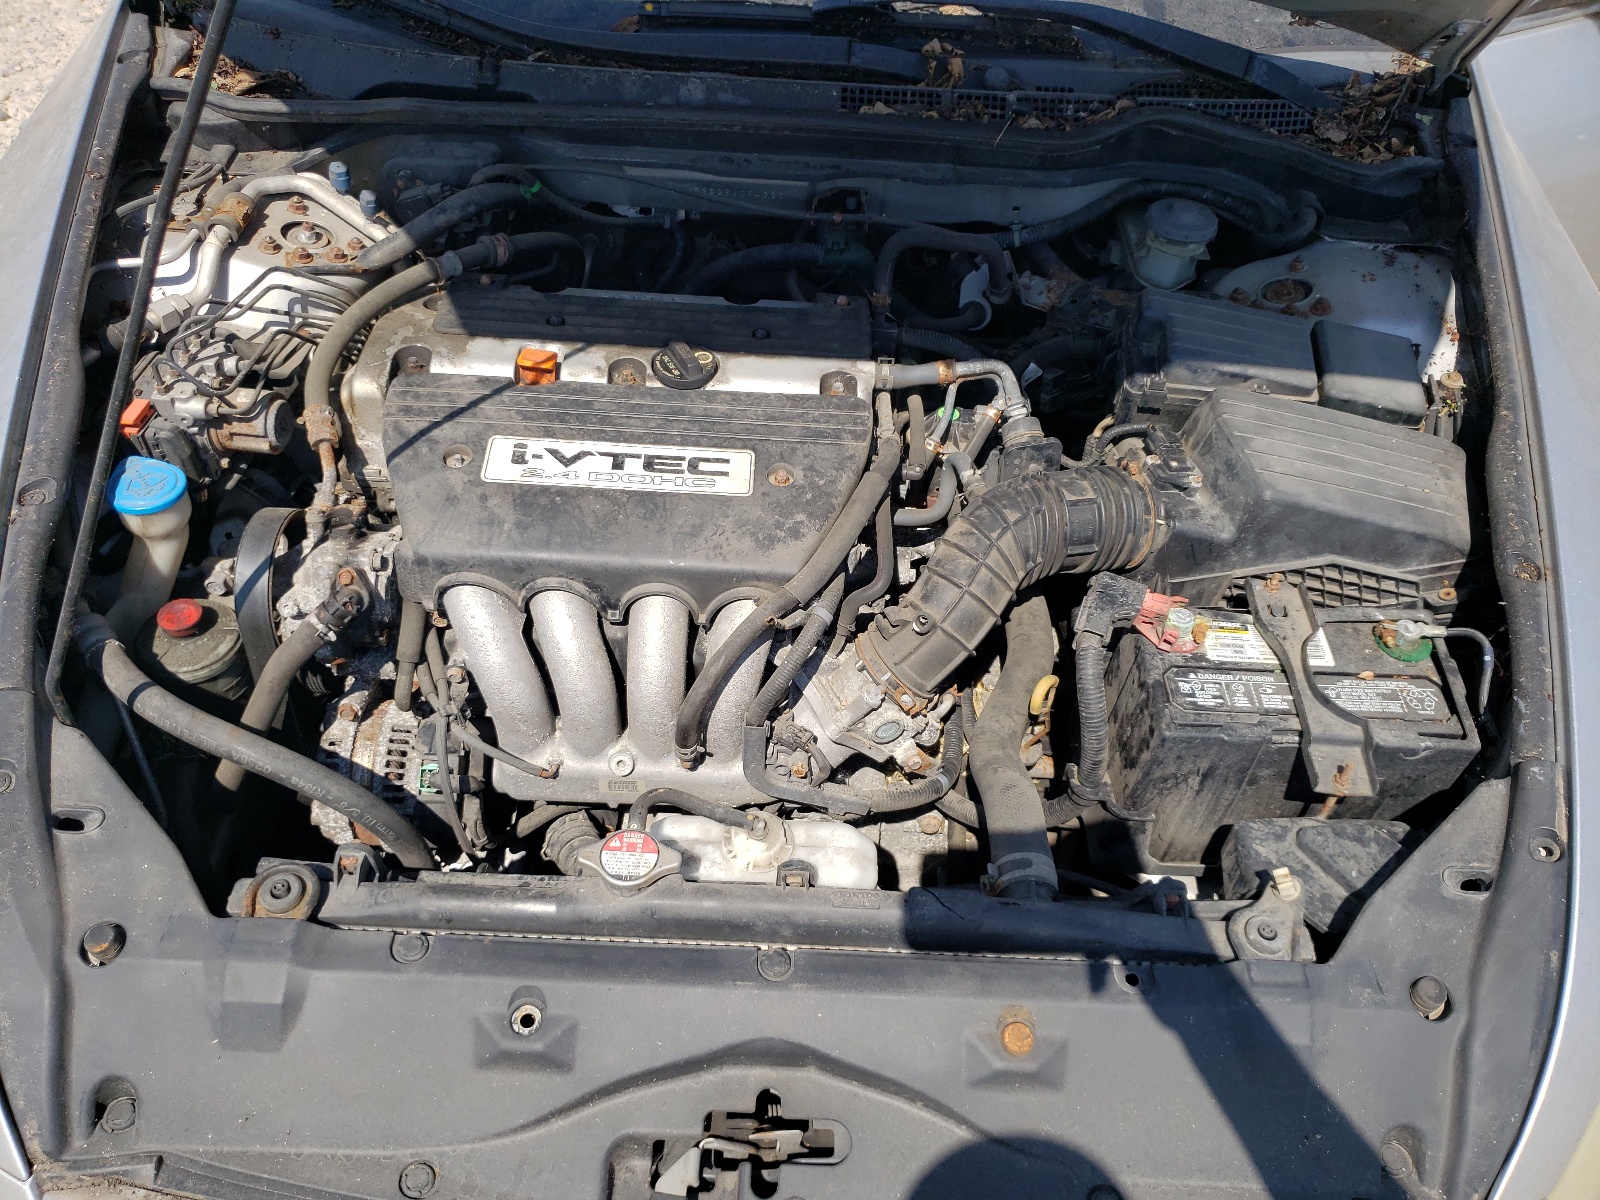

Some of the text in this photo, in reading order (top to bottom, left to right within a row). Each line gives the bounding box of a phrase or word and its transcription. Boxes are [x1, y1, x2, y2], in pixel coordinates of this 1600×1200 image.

[510, 443, 730, 477] i-VTEC
[520, 468, 717, 488] 2.4 DOHC
[1197, 673, 1234, 681] DANGER
